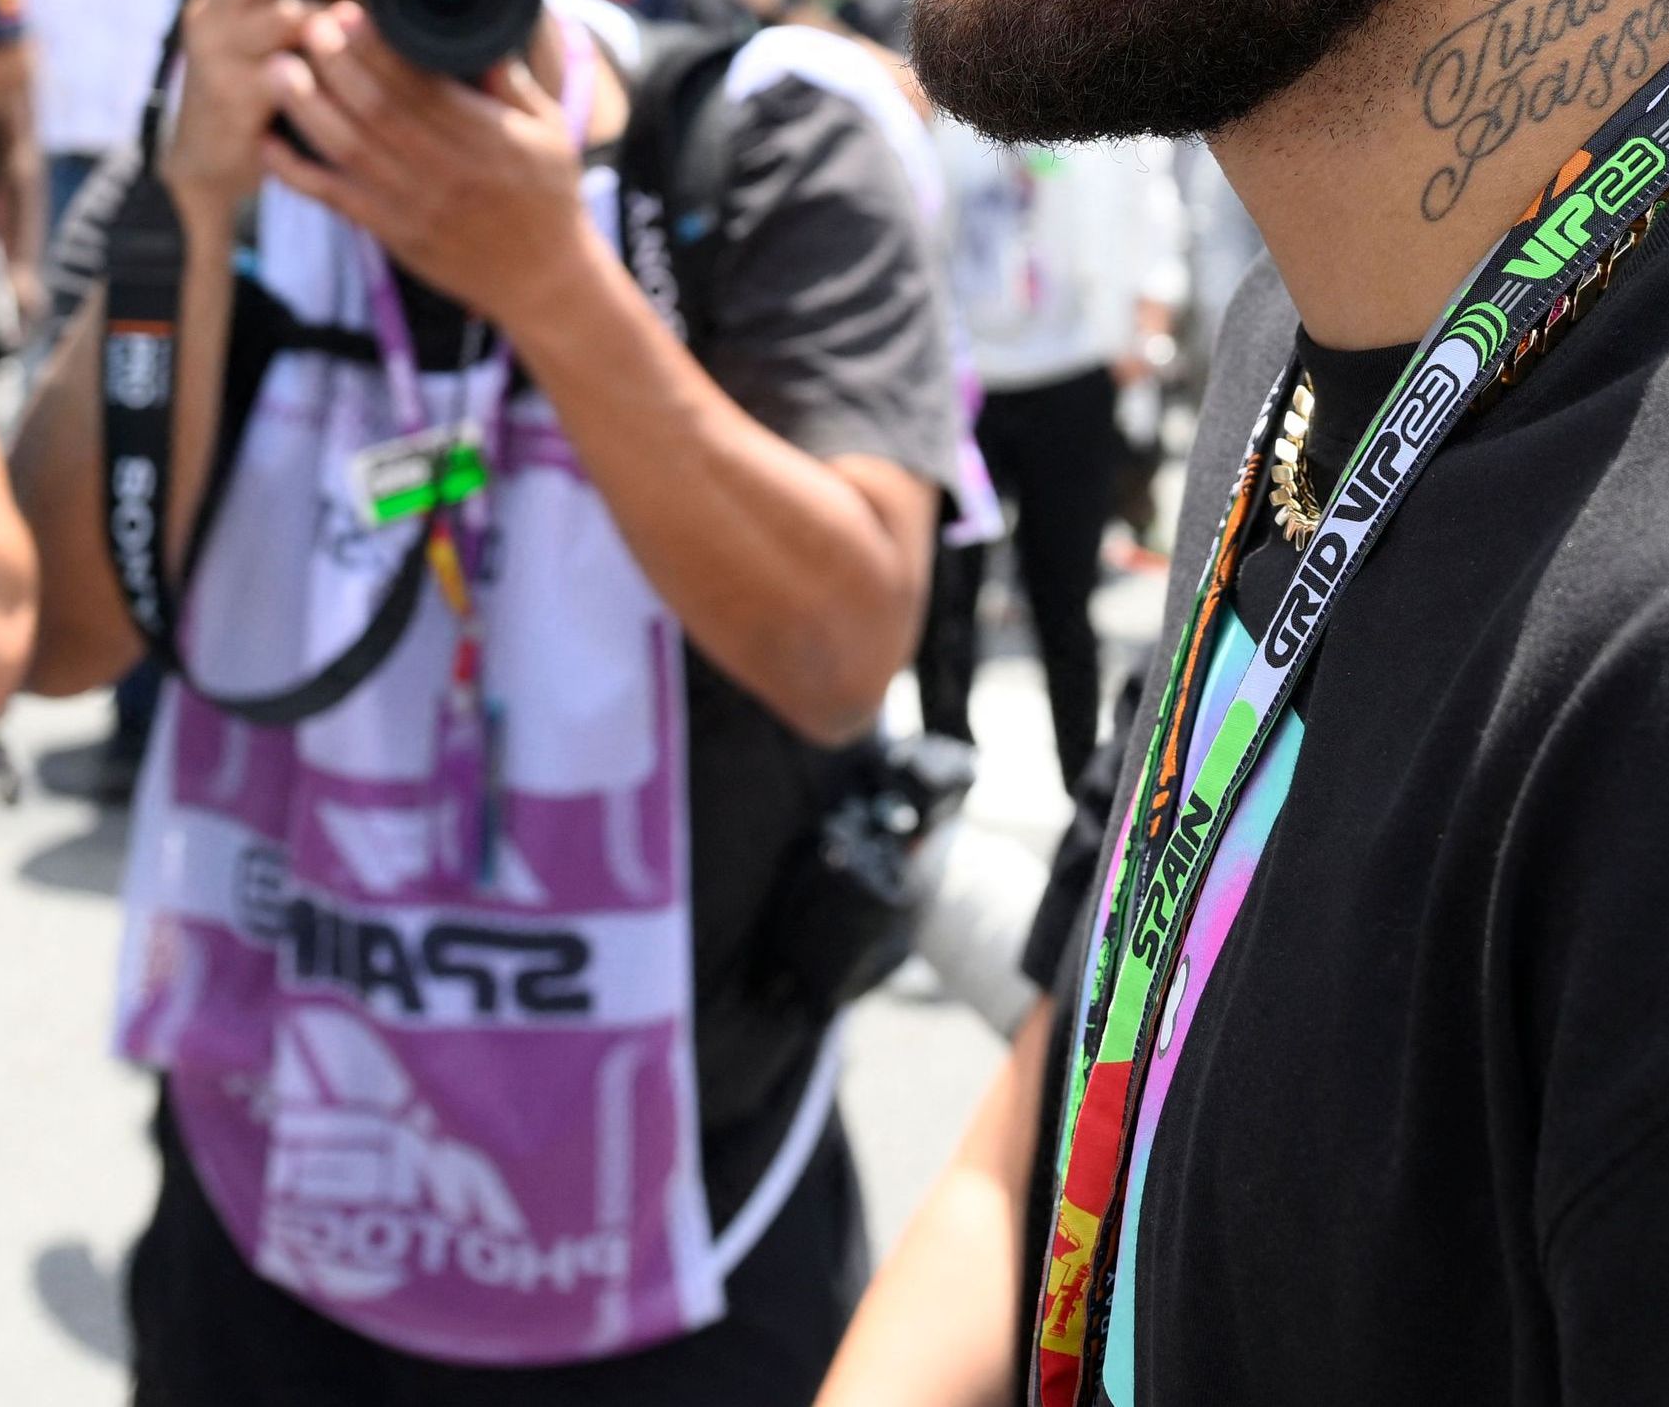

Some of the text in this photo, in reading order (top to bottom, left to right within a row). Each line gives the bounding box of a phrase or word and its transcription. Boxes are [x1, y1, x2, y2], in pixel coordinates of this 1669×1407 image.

[1501, 136, 1667, 280] VIP23
[1264, 531, 1349, 669] GRID
[1334, 363, 1460, 523] VIP23
[1132, 790, 1213, 971] SPAIN
